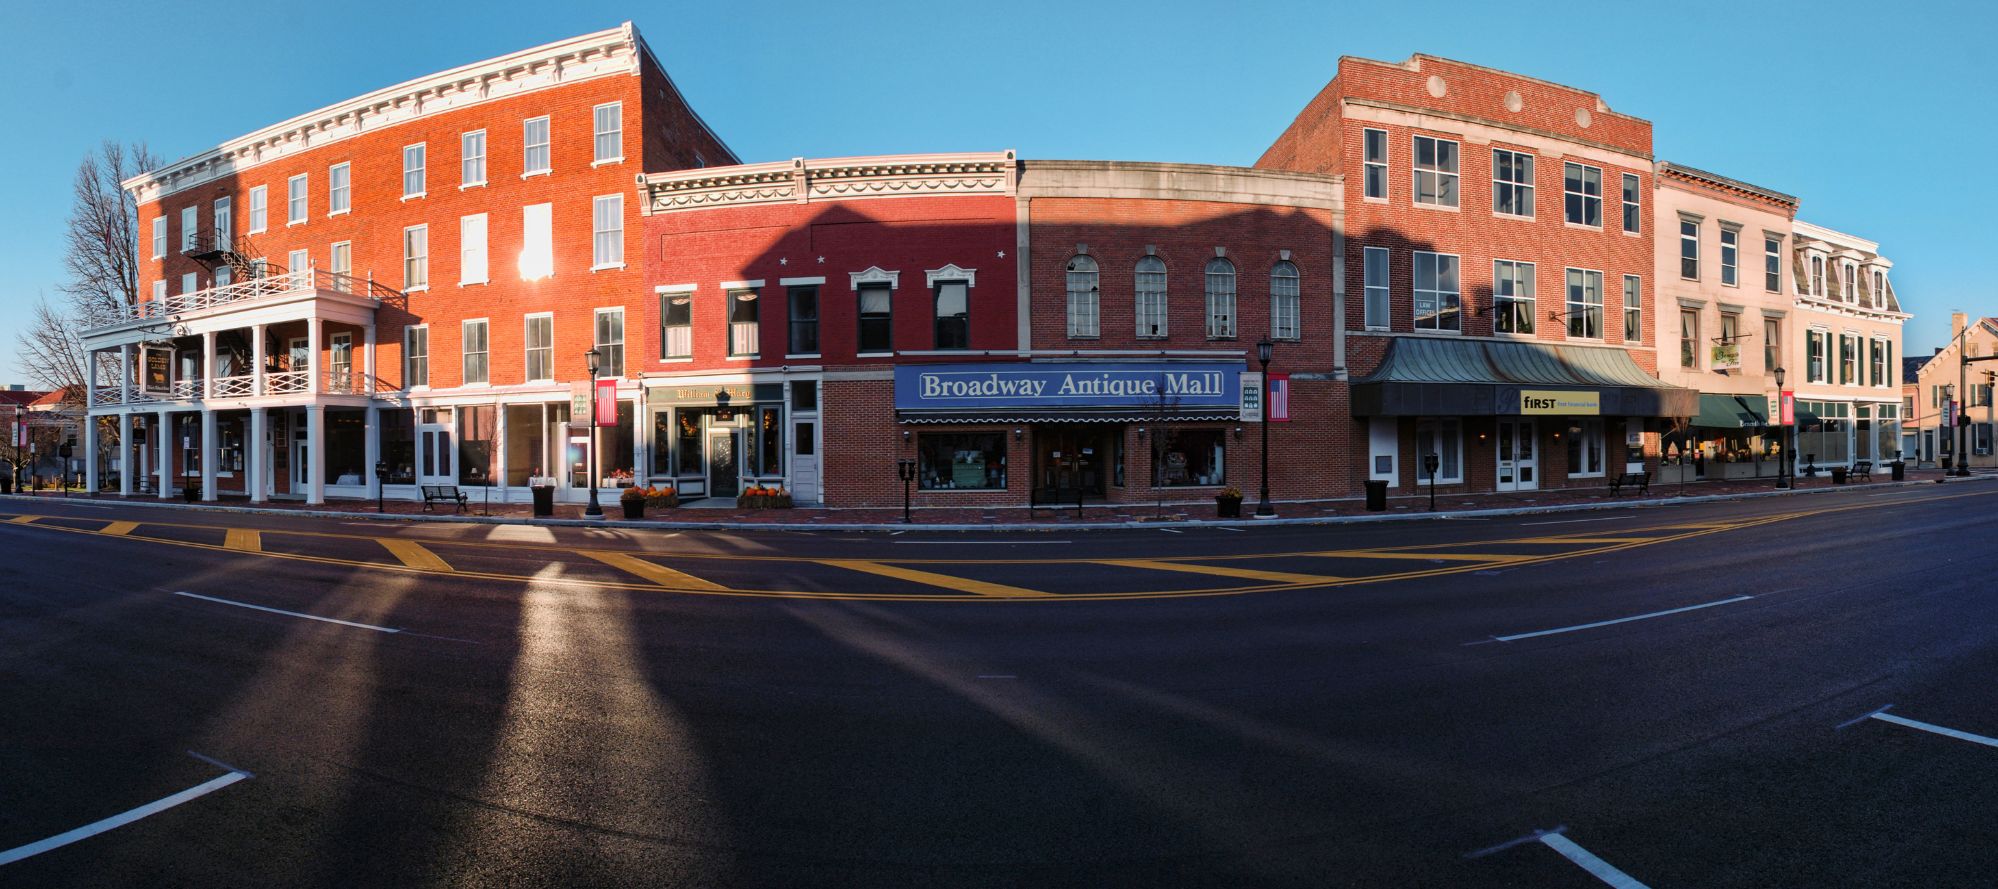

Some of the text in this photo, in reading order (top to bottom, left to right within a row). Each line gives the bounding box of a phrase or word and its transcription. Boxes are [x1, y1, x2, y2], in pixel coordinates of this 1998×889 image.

[678, 389, 710, 399] William
[726, 387, 751, 399] Mary
[923, 373, 1221, 397] Broadway Antique Mall
